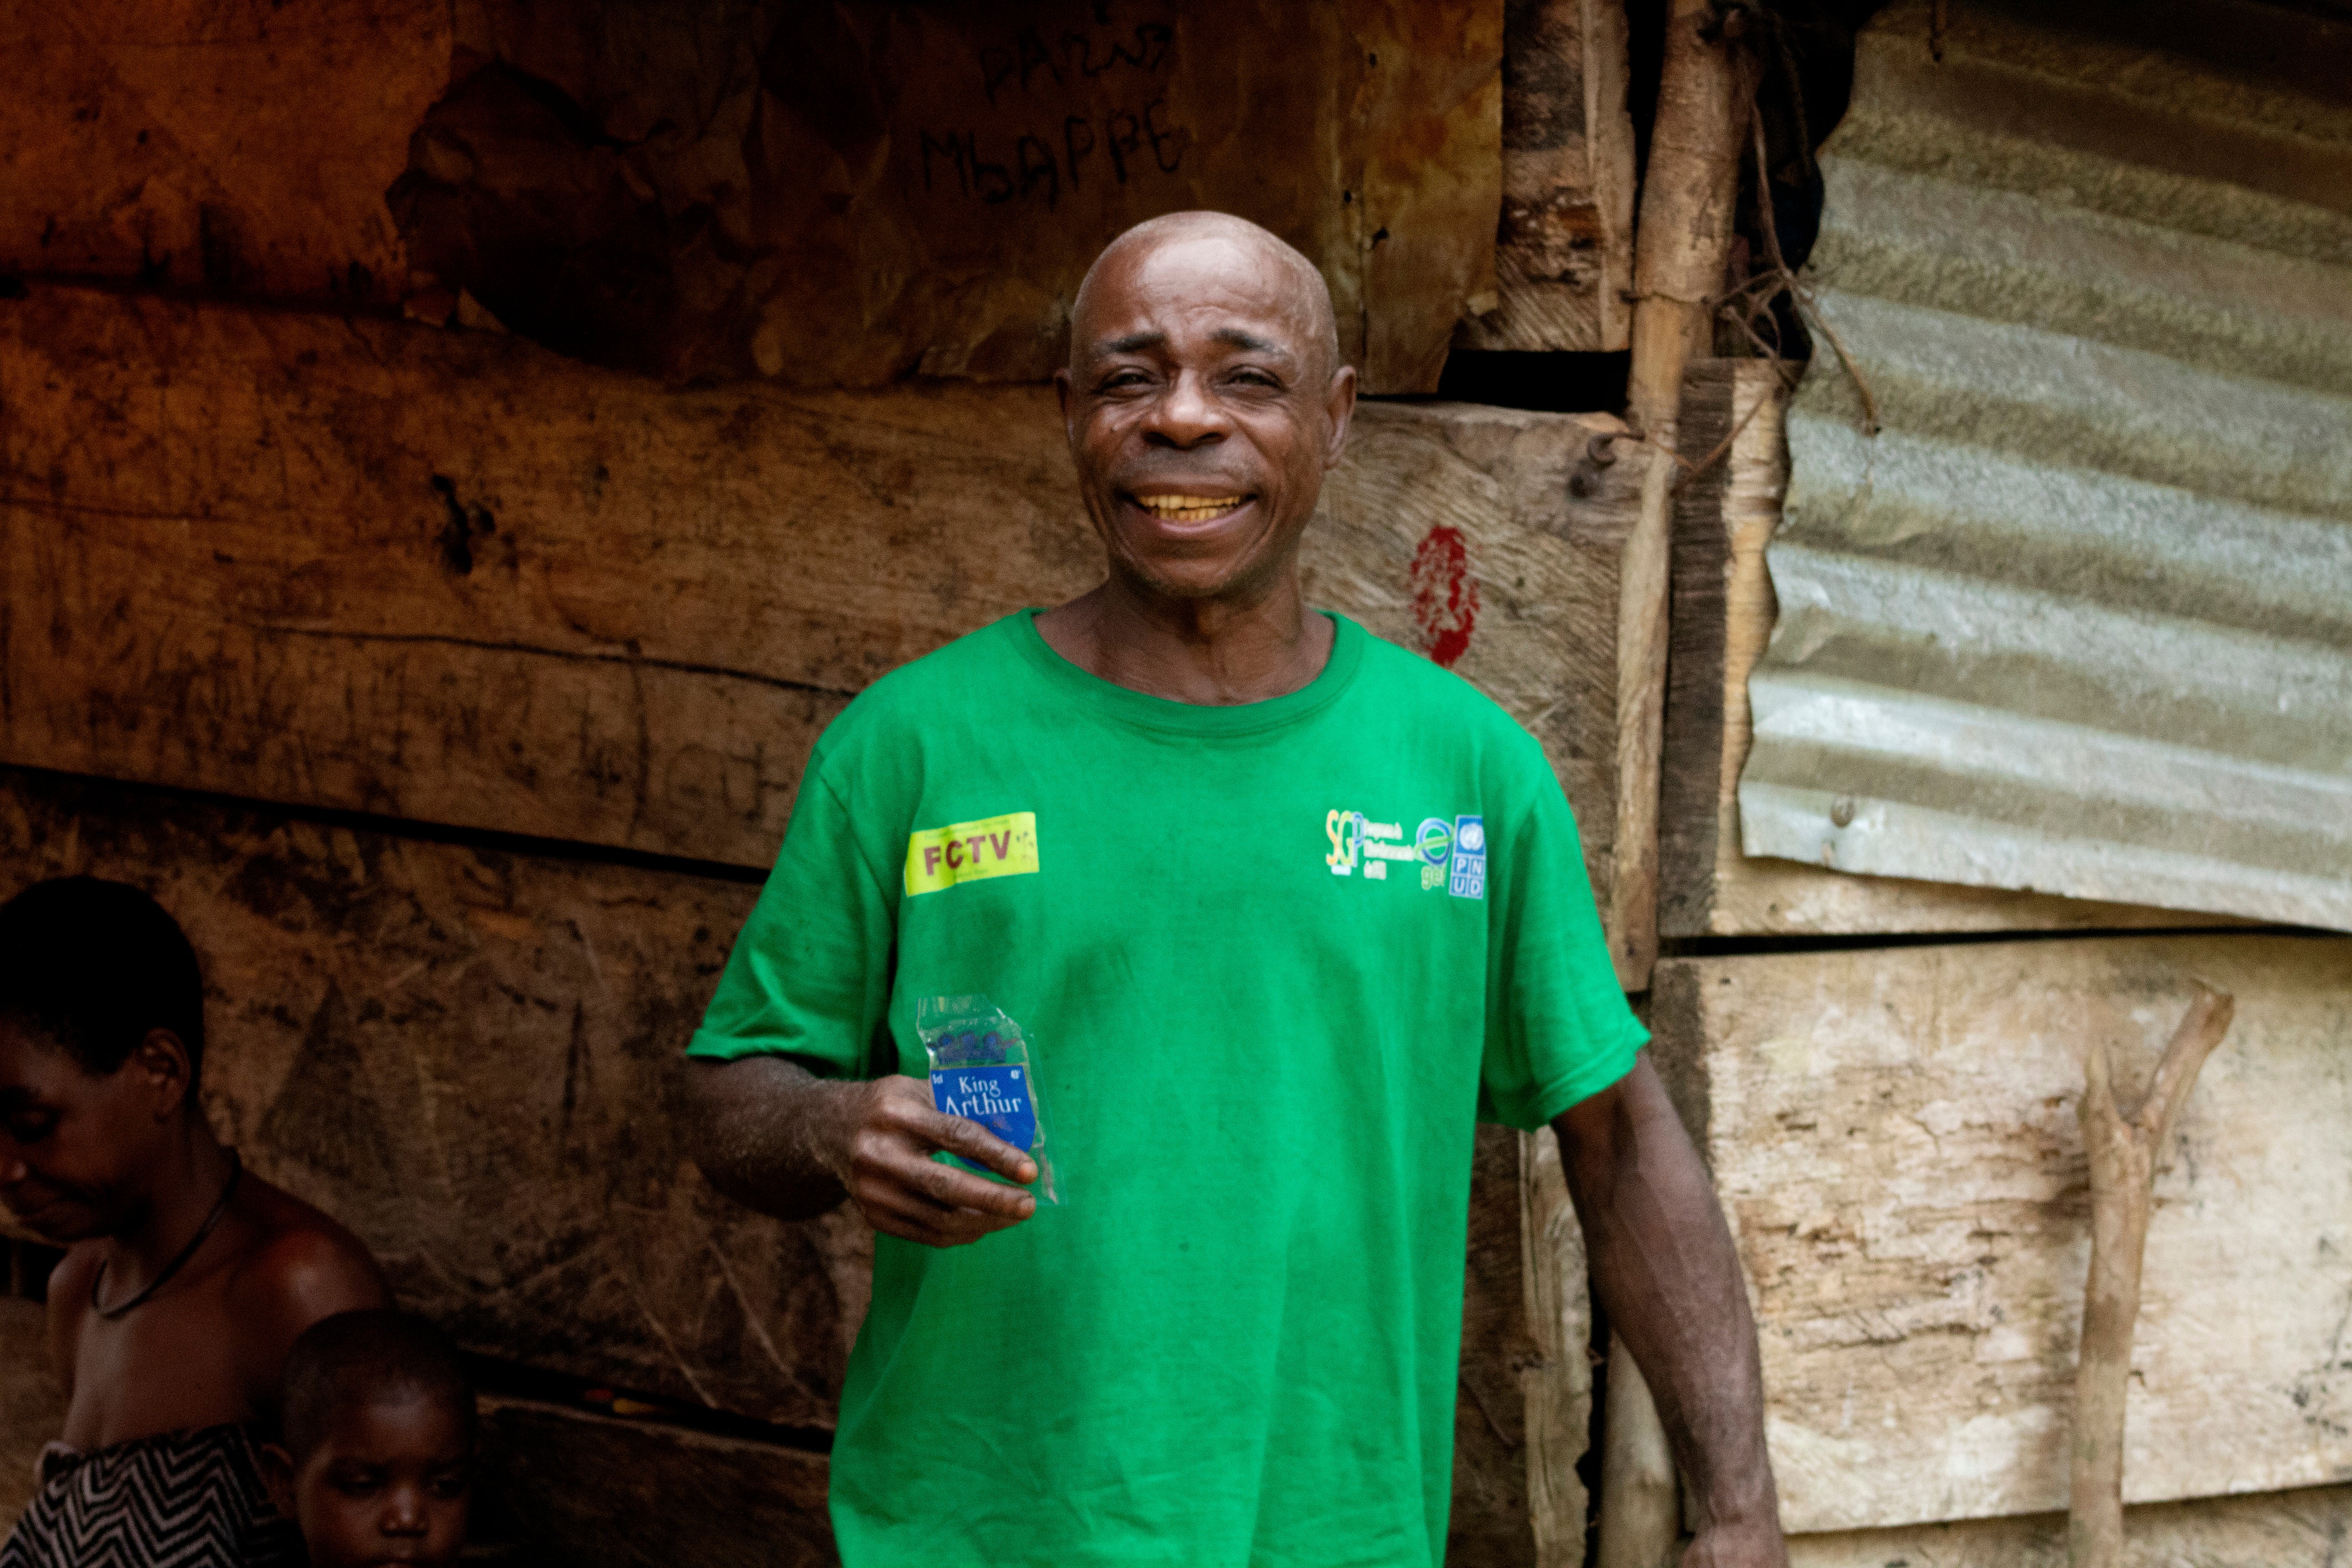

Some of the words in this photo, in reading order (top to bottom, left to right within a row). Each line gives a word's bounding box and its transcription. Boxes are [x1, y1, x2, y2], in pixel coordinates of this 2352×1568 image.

[924, 830, 1010, 876] FCTV
[958, 1075, 1001, 1098] King
[946, 1091, 1021, 1117] Arthur
